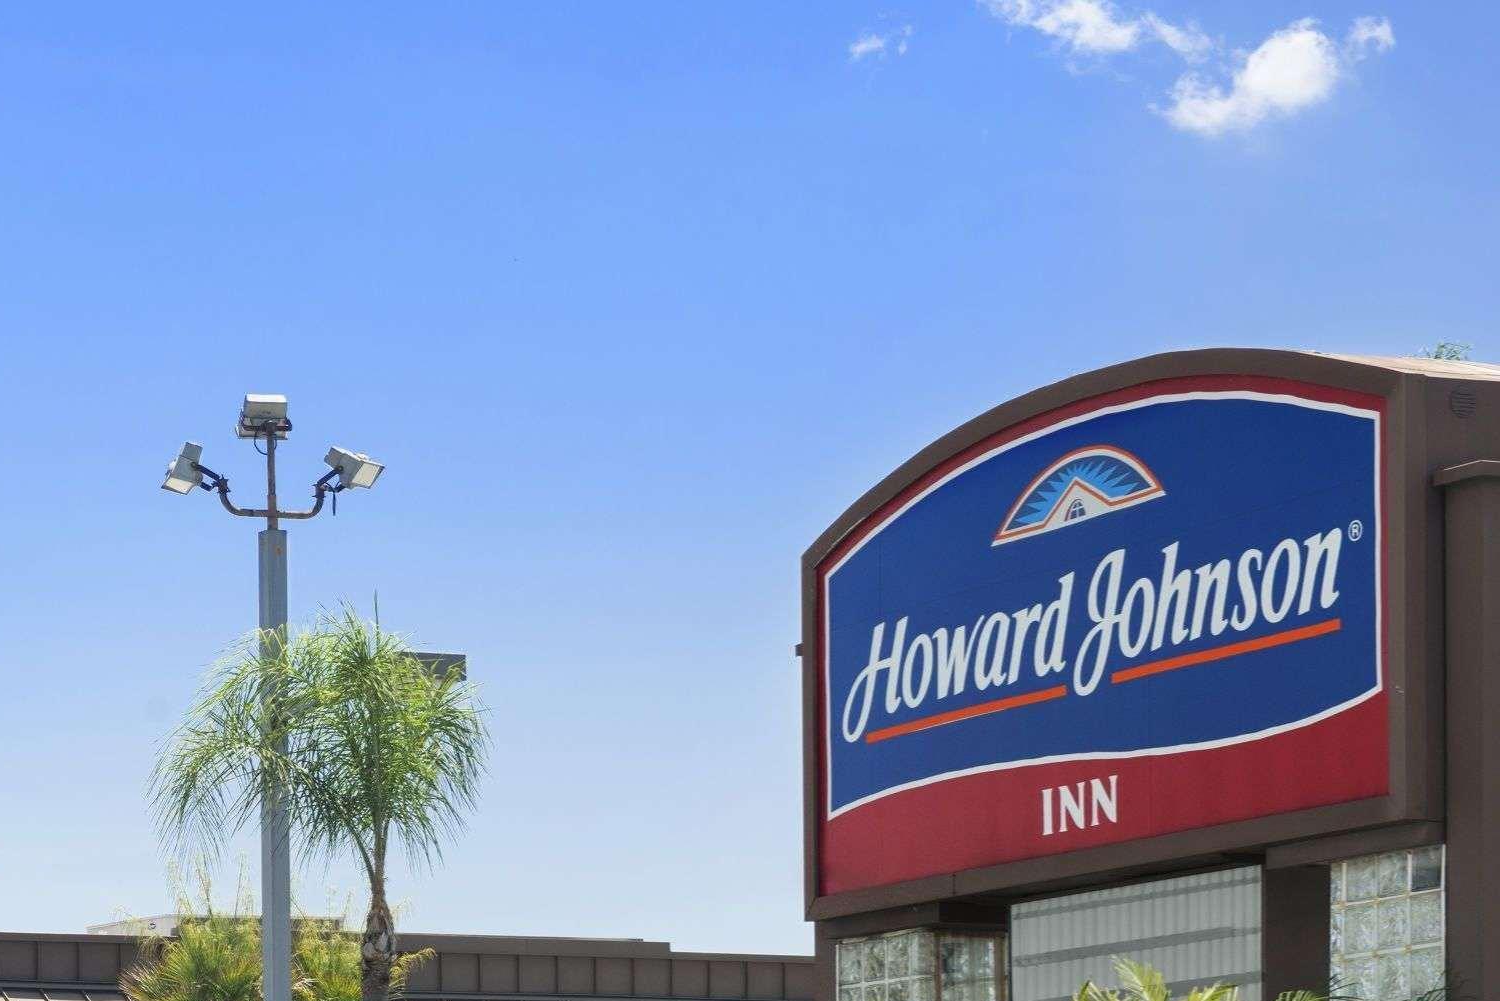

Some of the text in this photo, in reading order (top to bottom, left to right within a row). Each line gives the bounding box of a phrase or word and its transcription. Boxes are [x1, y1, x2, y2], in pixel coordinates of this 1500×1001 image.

[842, 527, 1342, 743] Howard Johnson
[1041, 775, 1118, 835] INN
